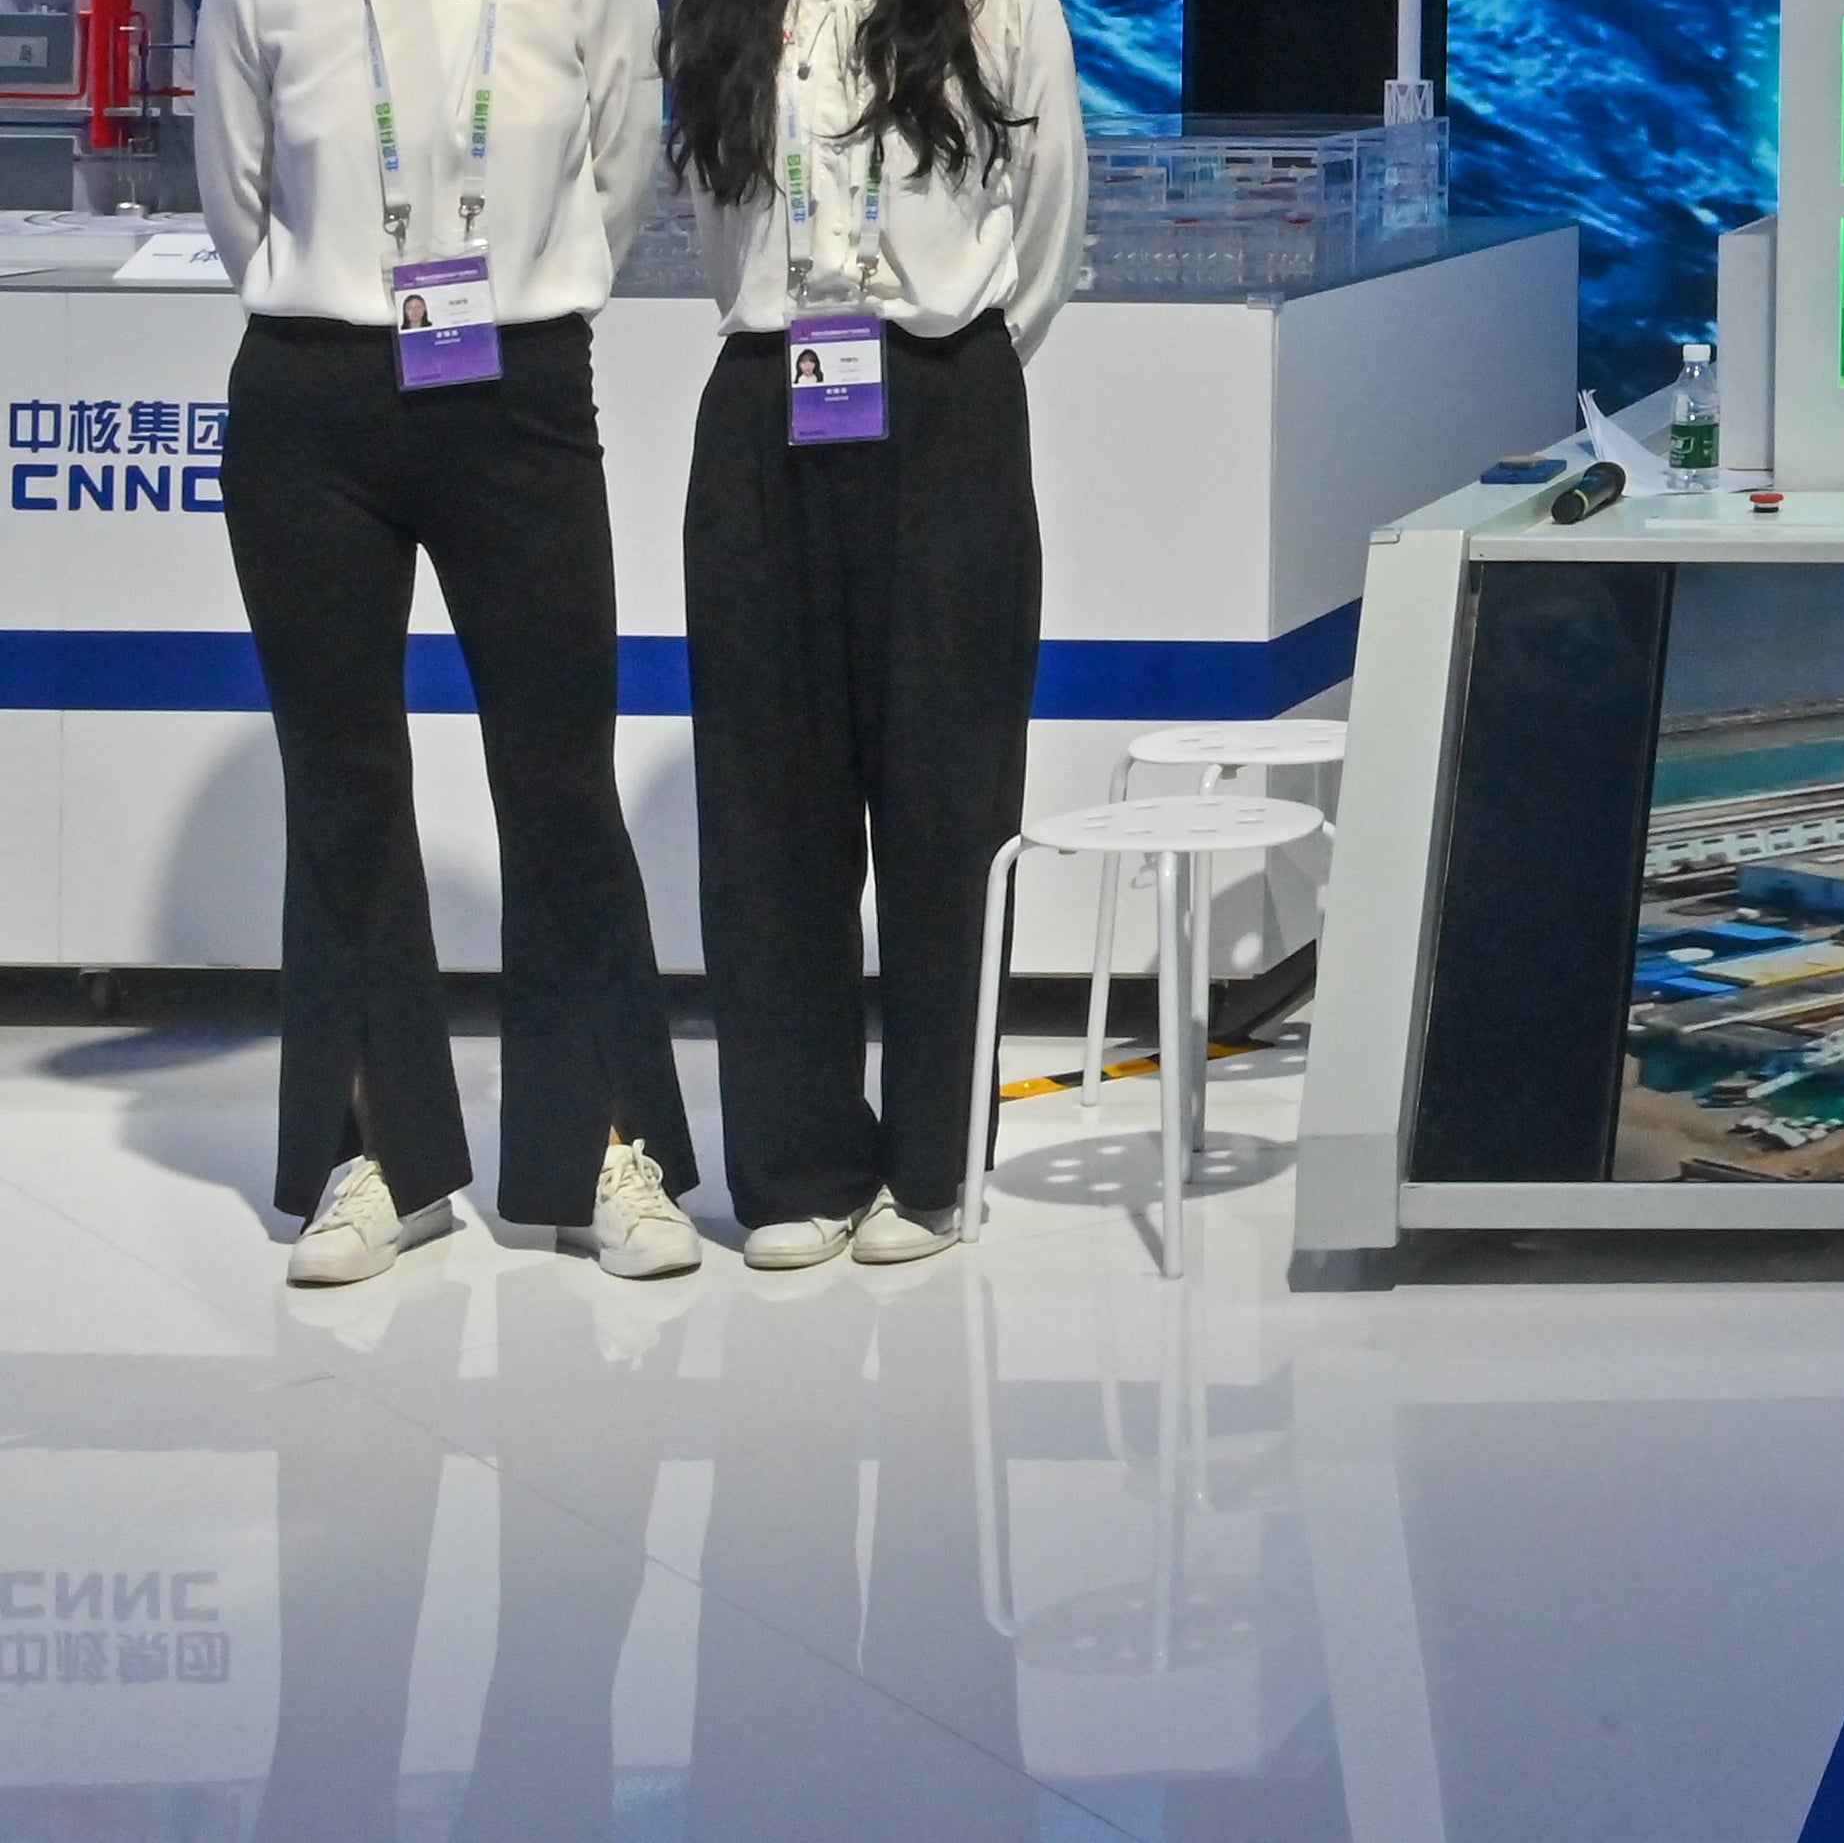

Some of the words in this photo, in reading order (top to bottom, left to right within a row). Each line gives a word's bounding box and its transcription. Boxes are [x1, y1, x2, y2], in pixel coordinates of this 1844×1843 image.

[10, 400, 229, 455] 中核集团
[12, 464, 225, 513] CNNC
